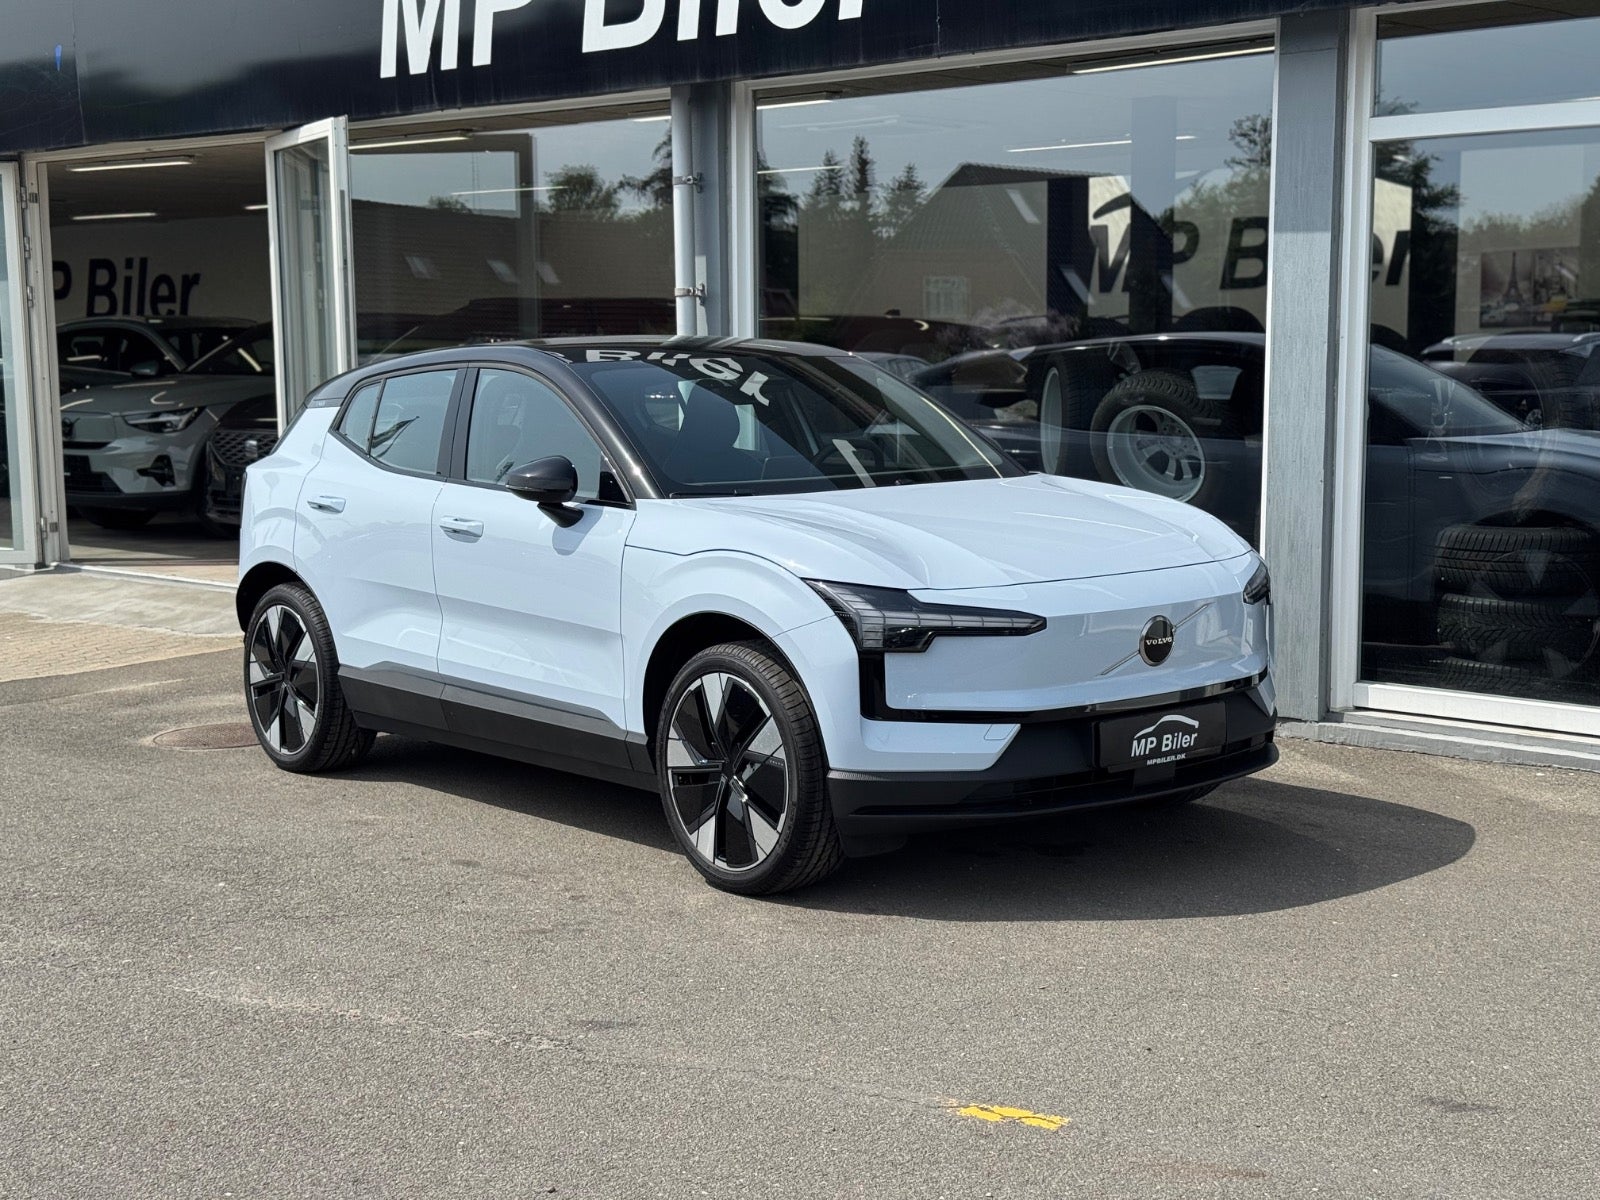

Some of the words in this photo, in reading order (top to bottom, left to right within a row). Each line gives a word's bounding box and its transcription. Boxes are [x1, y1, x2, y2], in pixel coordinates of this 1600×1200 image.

[86, 257, 201, 317] Biler
[1145, 636, 1172, 645] VOLVO
[1131, 737, 1157, 757] MP
[1161, 731, 1198, 752] Biler
[1146, 753, 1186, 766] MPBILER.DK
